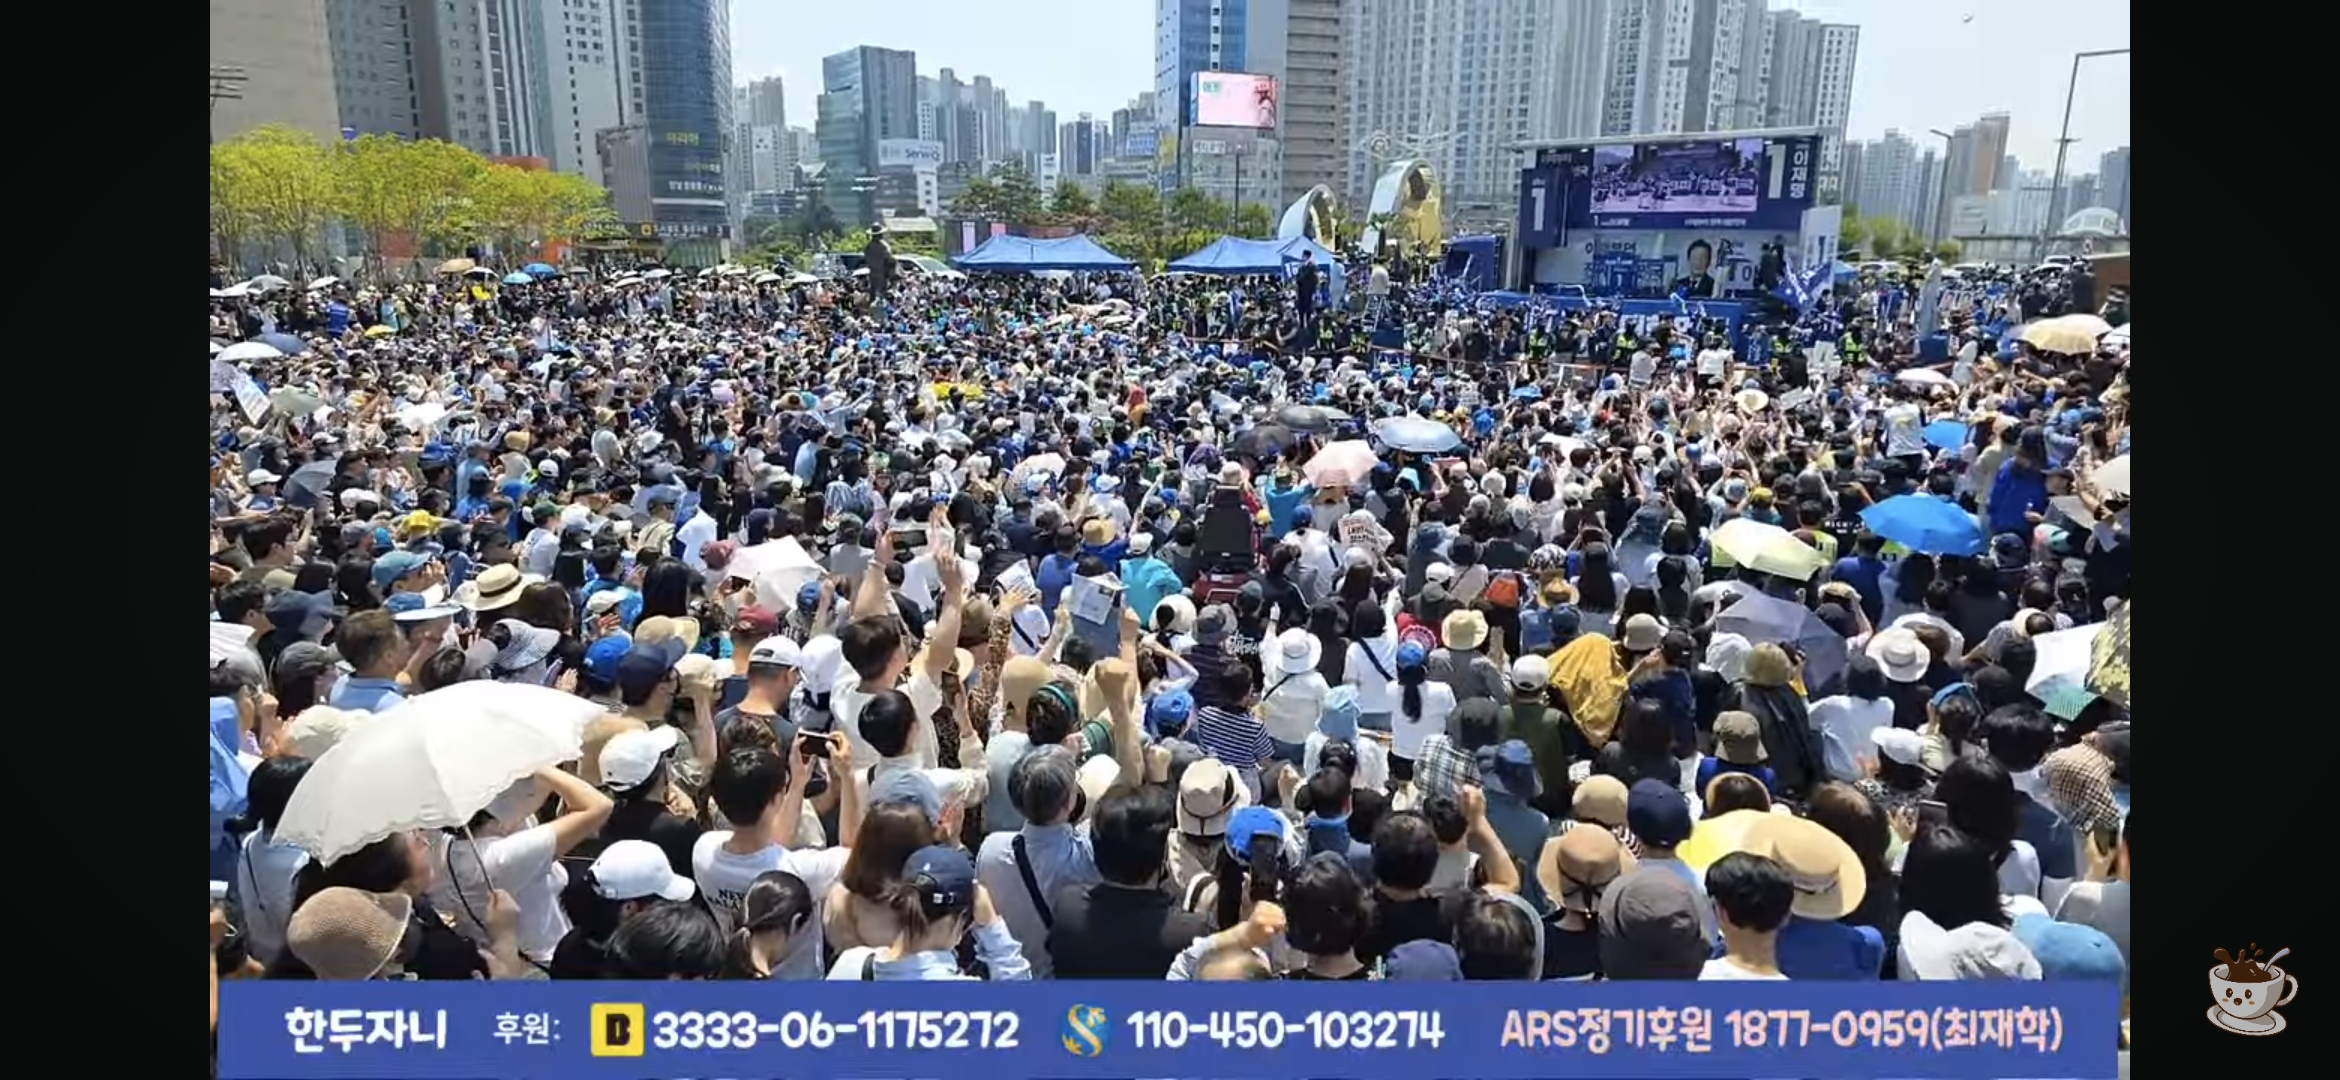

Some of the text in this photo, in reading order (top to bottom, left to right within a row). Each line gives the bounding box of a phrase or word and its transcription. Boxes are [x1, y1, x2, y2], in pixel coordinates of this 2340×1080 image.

[1766, 144, 1786, 199] 1
[1790, 151, 1809, 199] 이재명
[1531, 188, 1546, 231] 1
